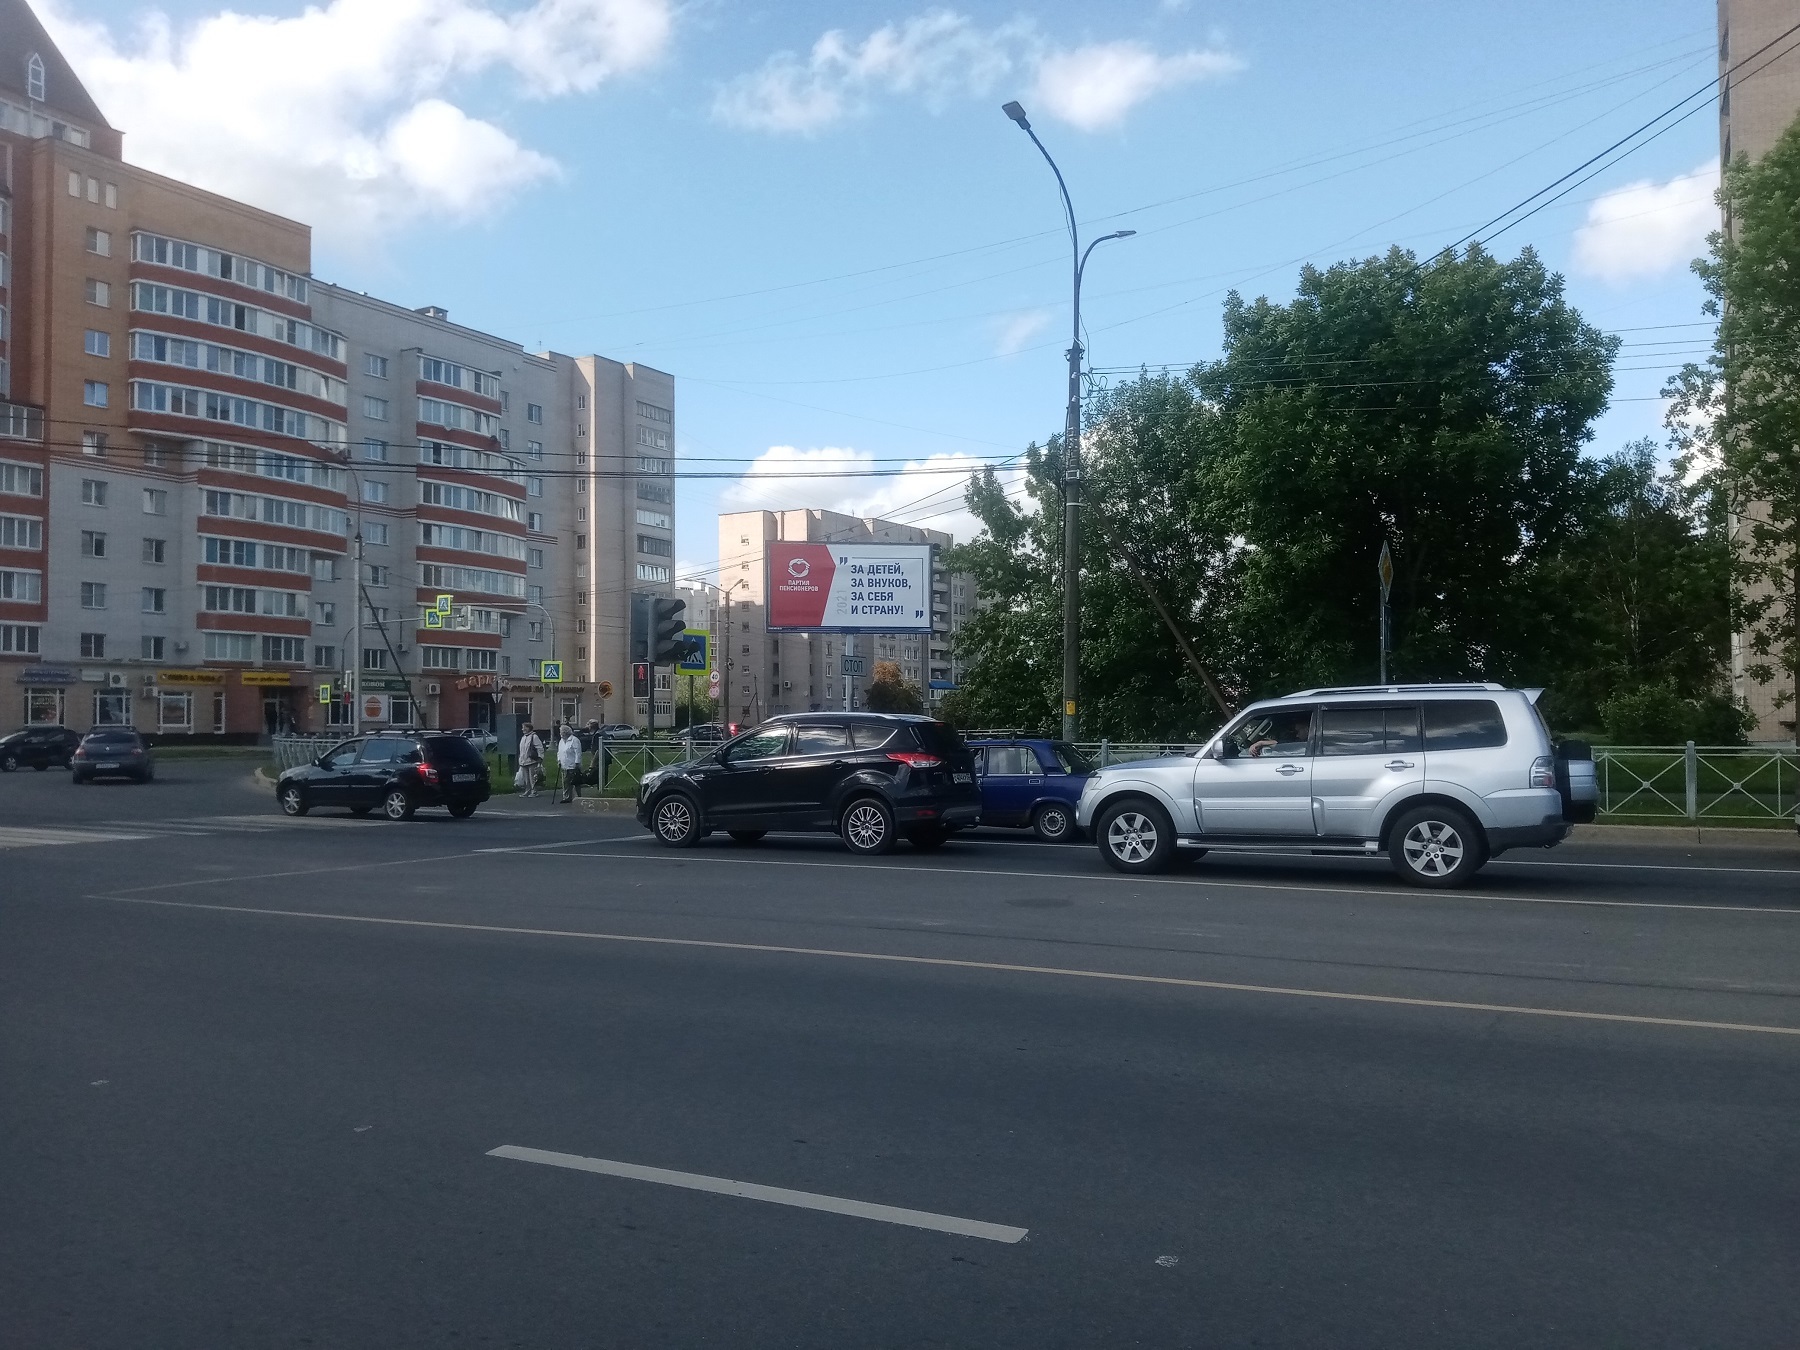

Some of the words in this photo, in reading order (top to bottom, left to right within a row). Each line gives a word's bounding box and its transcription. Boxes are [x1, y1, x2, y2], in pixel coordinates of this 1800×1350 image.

[850, 565, 864, 575] ЗА
[867, 563, 904, 576] ДЕТЕЙ,
[850, 578, 864, 588] ЗА
[867, 578, 912, 590] ВНУКОВ,
[837, 589, 847, 615] 2021
[850, 592, 864, 601] ЗА
[867, 592, 894, 602] СЕБЯ
[851, 606, 859, 615] И
[861, 605, 904, 615] СТРАНУ!
[844, 659, 863, 673] СТОП
